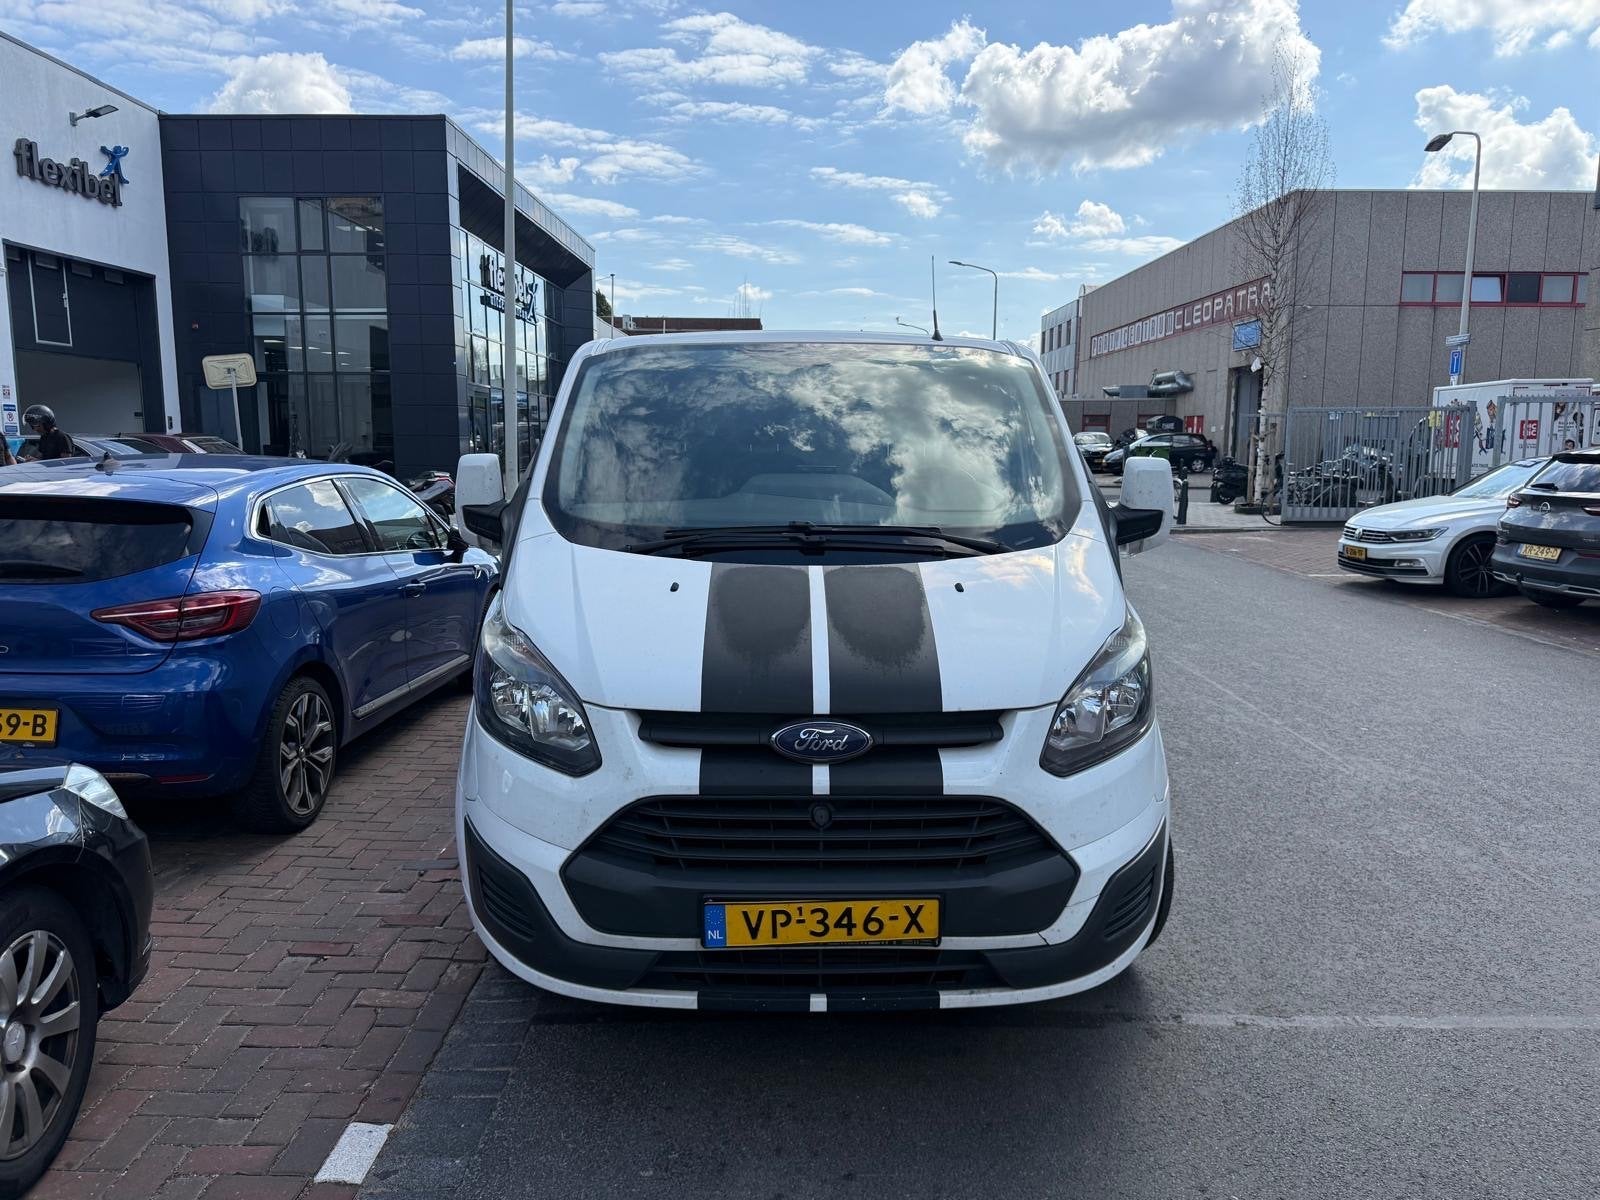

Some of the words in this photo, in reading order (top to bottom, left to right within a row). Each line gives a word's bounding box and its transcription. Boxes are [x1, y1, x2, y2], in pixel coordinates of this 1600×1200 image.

[13, 138, 122, 208] flexibel
[1174, 282, 1271, 329] CLEOPATRA
[0, 712, 47, 737] 9-B
[794, 728, 849, 751] Ford
[707, 930, 724, 940] NL
